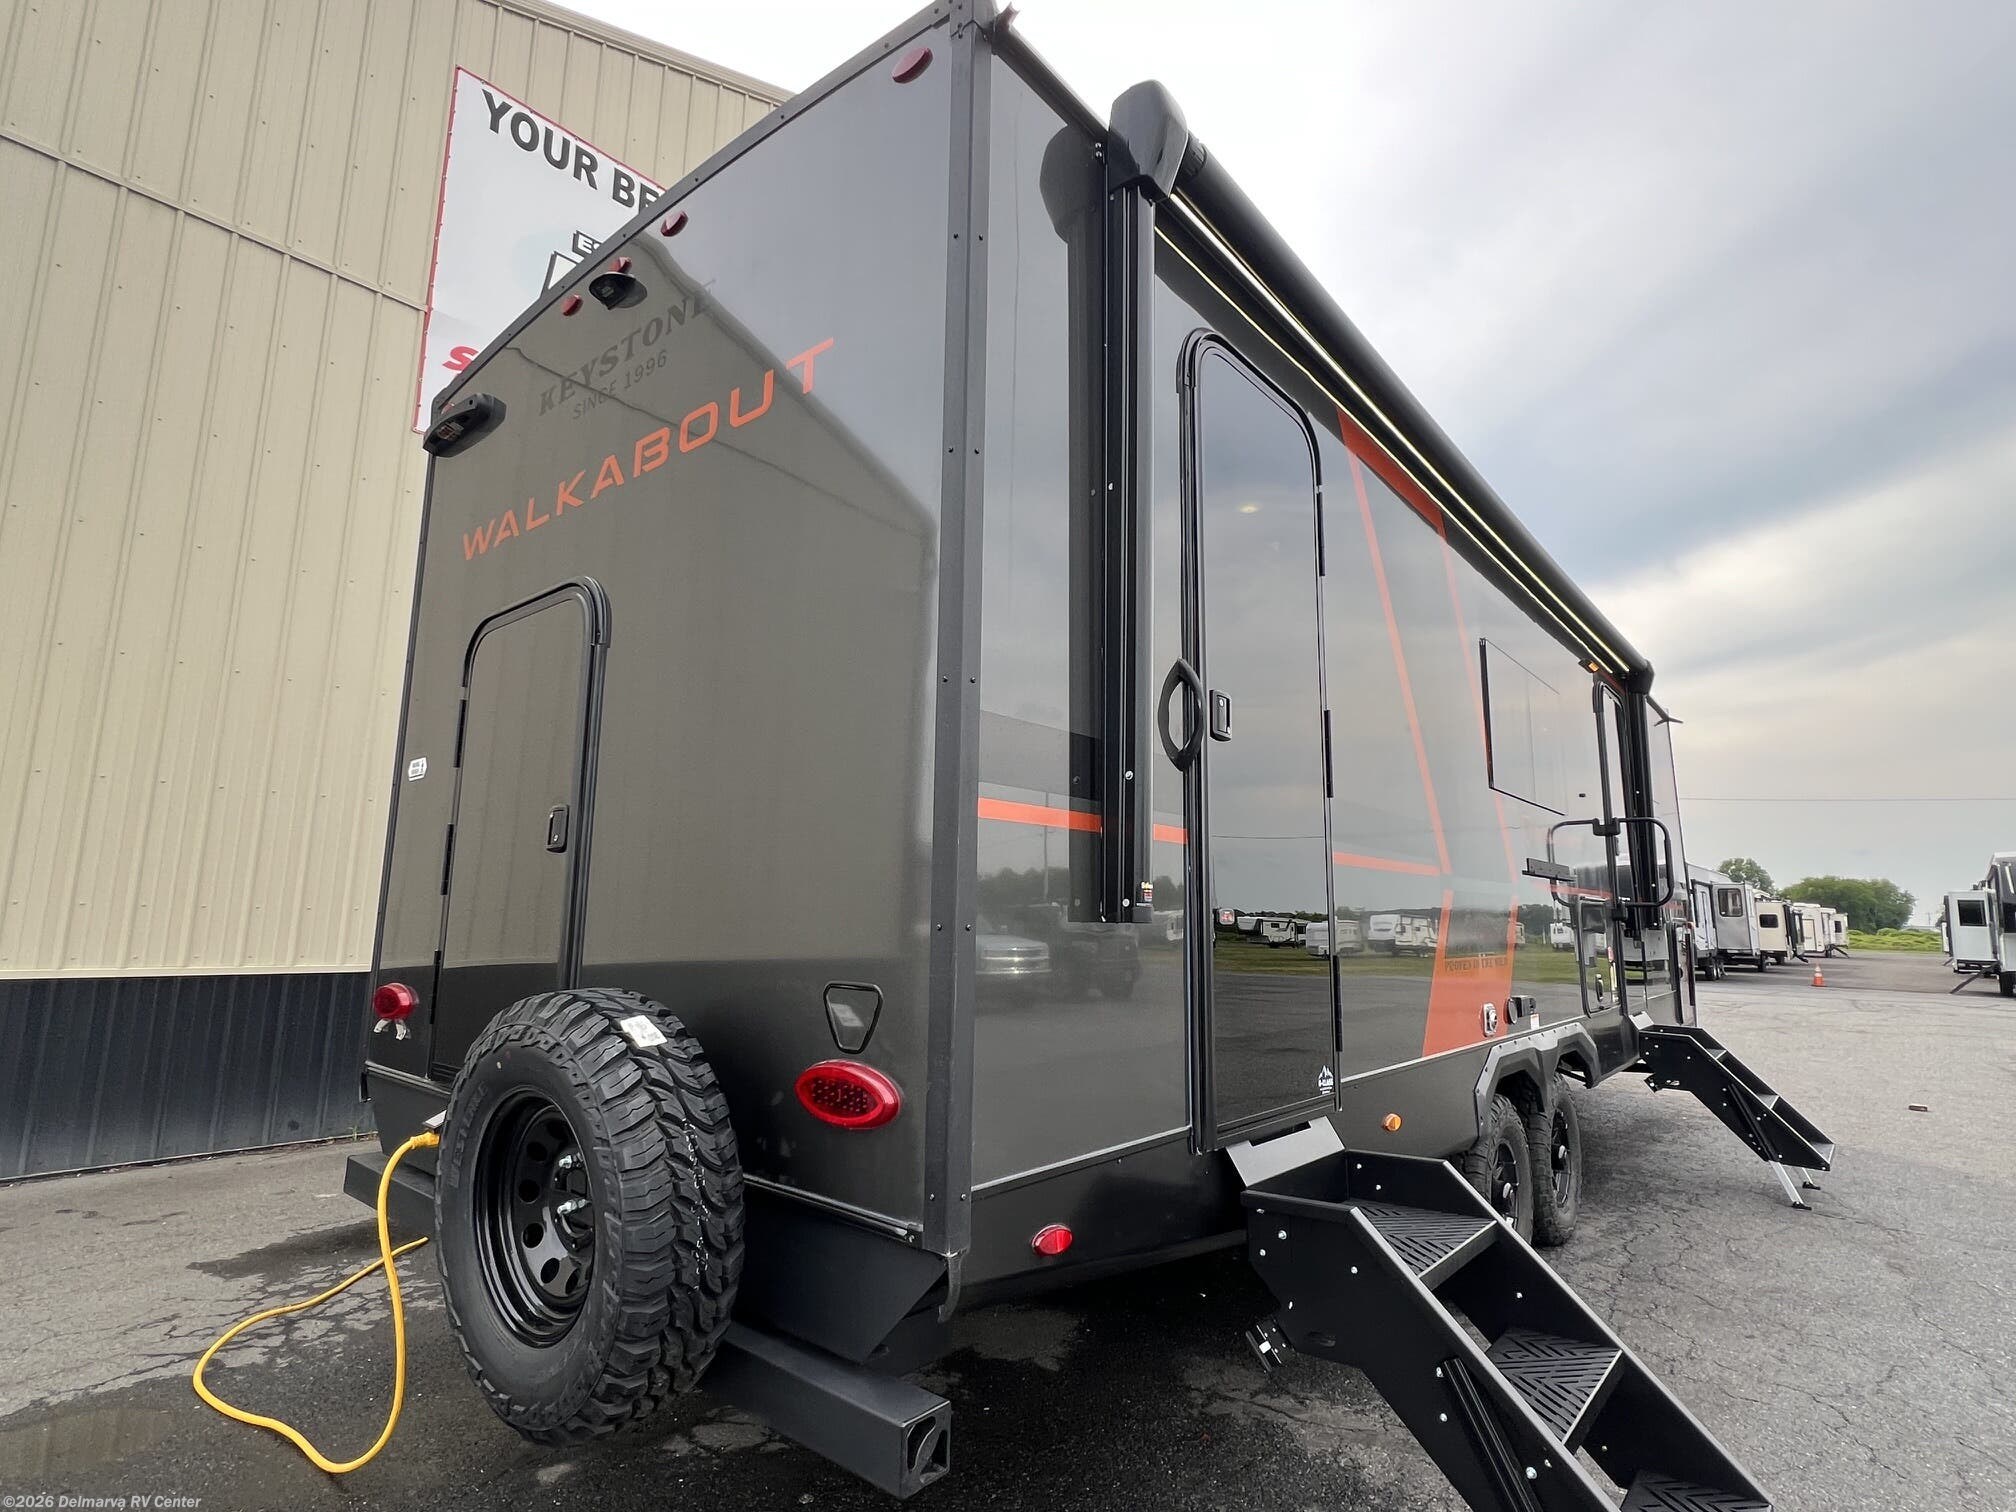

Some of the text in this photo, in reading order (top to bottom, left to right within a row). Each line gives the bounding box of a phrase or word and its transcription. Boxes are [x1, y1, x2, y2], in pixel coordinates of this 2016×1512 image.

[481, 88, 599, 190] YOUR
[538, 279, 716, 416] KEYSTONE
[572, 349, 667, 420] SINCE 1996
[462, 336, 834, 561] WALKABOUT
